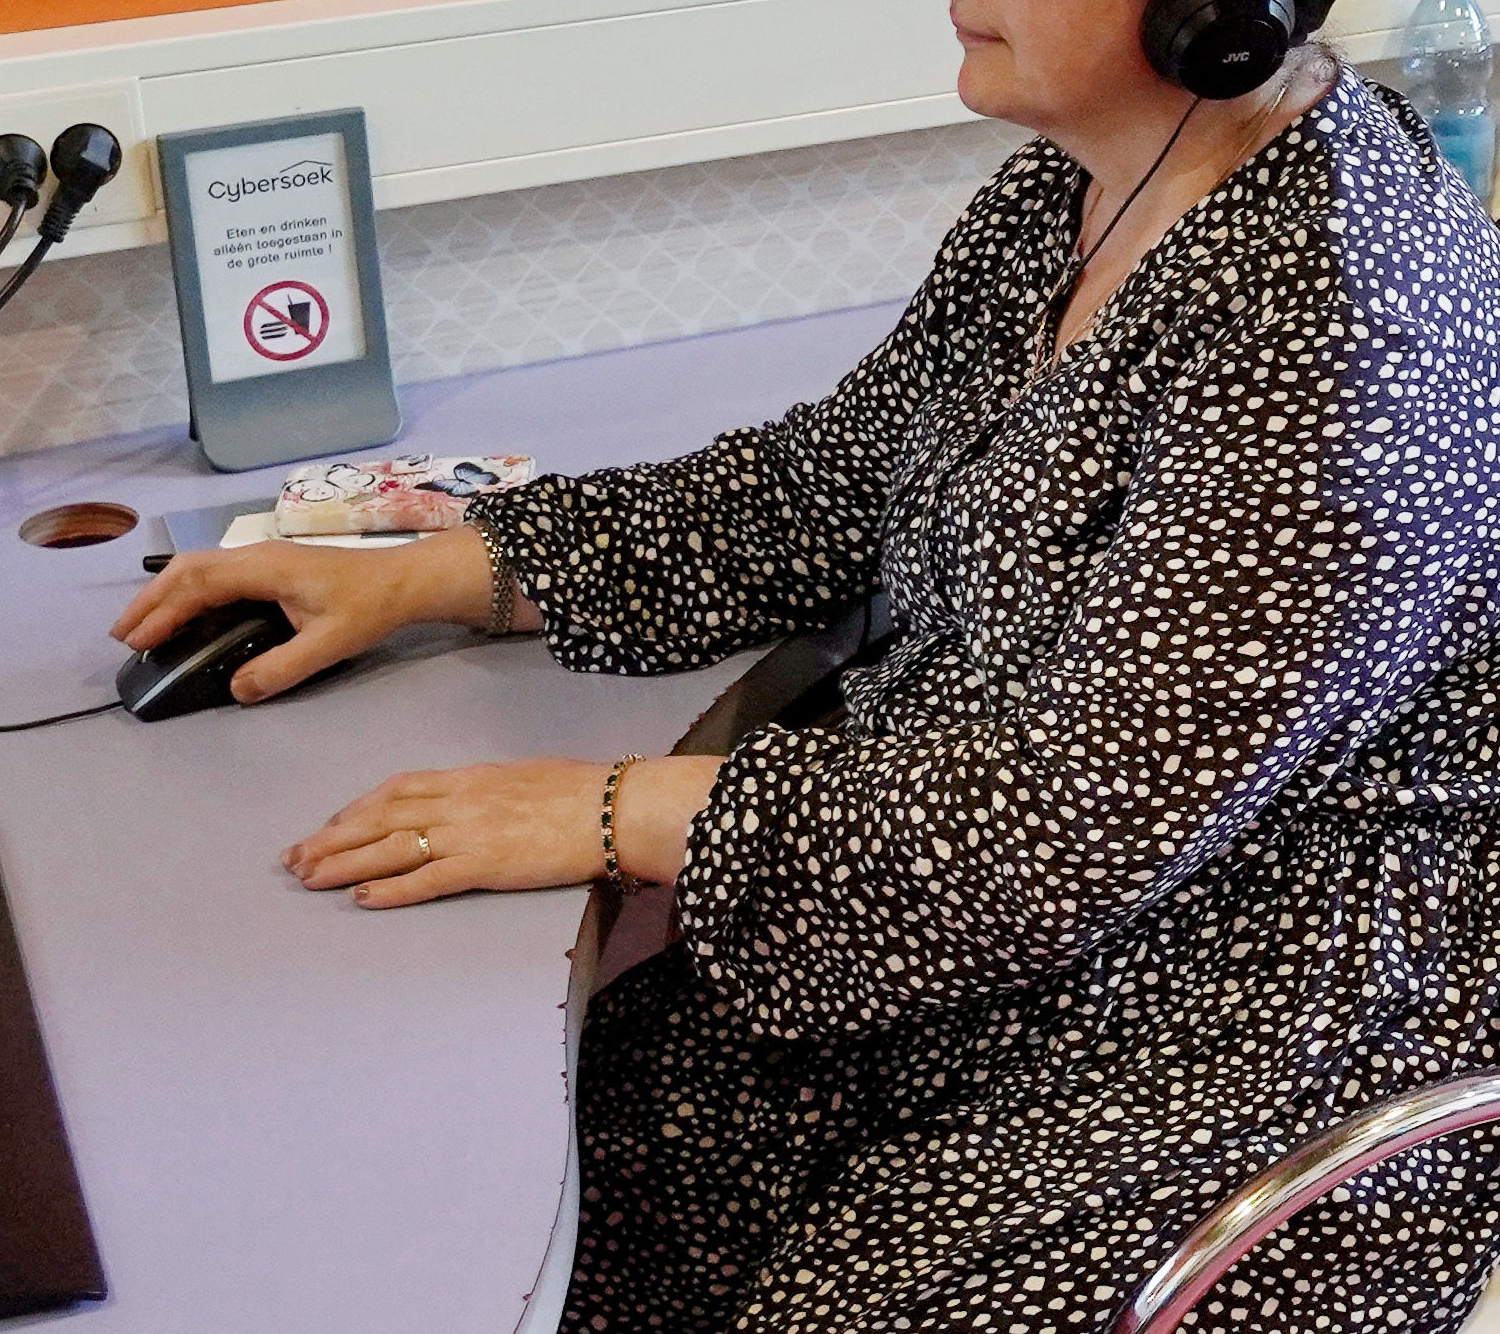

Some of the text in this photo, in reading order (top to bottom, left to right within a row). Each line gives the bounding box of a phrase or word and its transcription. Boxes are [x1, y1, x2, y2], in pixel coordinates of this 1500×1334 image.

[1223, 51, 1250, 63] JVC
[208, 166, 334, 203] Cybersoek
[226, 216, 327, 240] Eten en drinken
[331, 228, 343, 239] in
[227, 257, 243, 269] de
[247, 253, 280, 269] grote
[284, 246, 325, 260] ruimte
